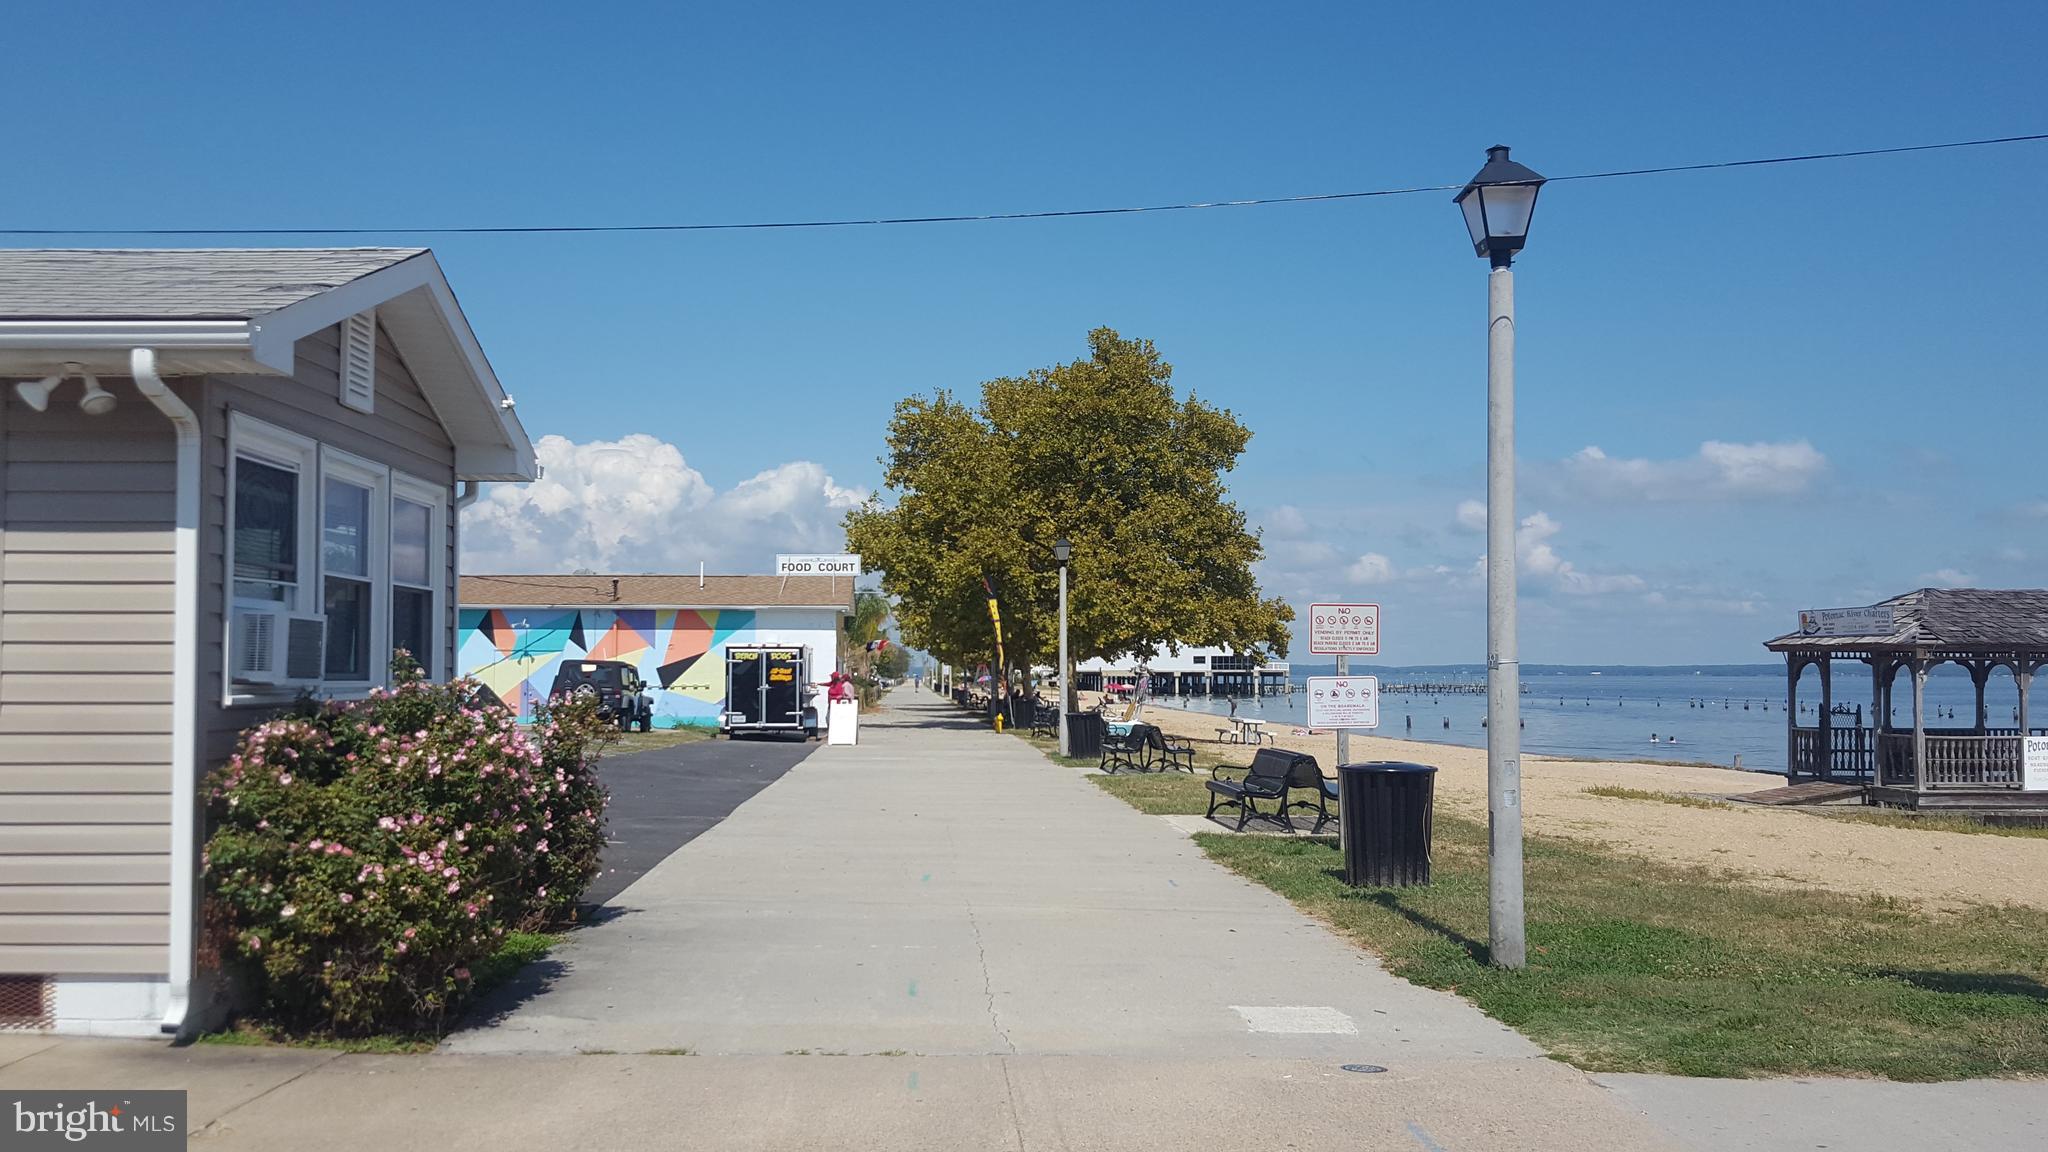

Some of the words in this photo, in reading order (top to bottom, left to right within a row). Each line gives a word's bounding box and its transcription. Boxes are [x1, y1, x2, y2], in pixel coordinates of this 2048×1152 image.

[781, 563, 812, 572] FOOD
[818, 563, 855, 572] COURT
[1338, 607, 1351, 615] NO
[1847, 609, 1861, 618] River
[1863, 606, 1890, 619] Charters
[770, 652, 792, 660] DOGS
[1336, 680, 1348, 688] NO
